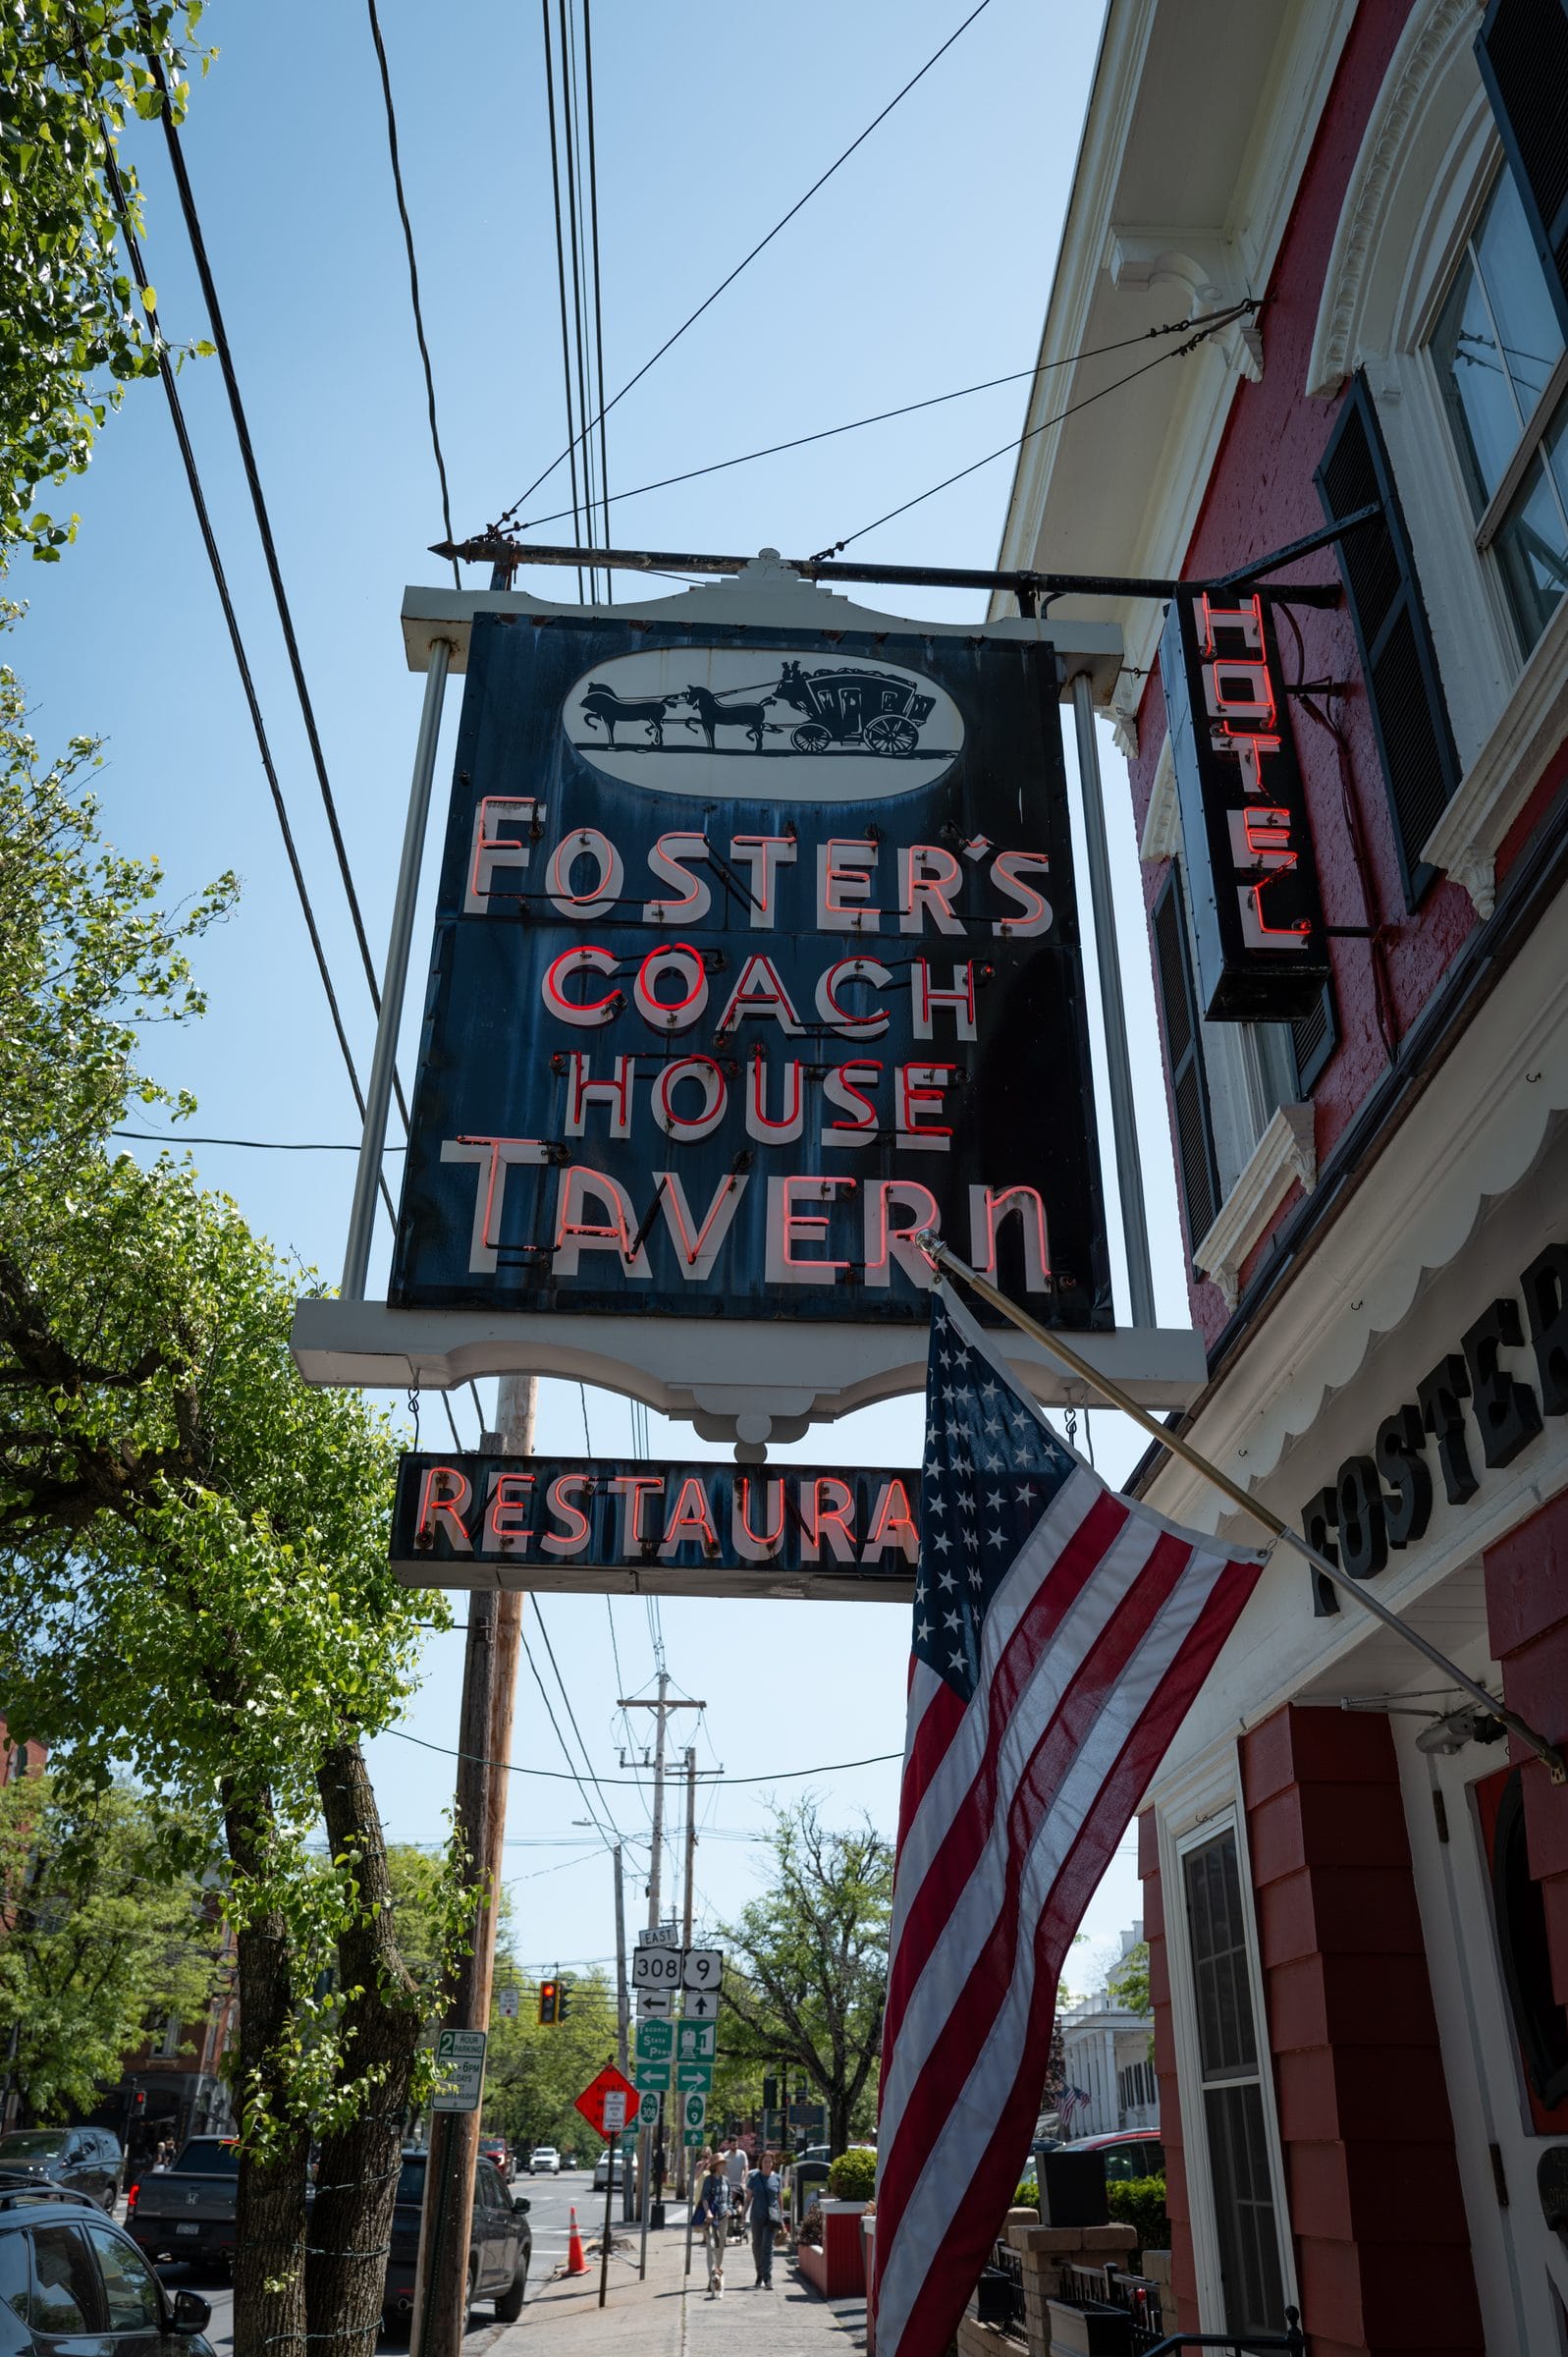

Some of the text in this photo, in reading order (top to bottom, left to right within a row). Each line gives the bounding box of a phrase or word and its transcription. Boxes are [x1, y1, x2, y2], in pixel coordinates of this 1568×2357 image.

[1191, 591, 1311, 950] HOTEL
[462, 796, 1054, 938] FOSTER'S
[541, 943, 978, 1042] COACH
[563, 1050, 959, 1151] HOUSE
[644, 1929, 672, 1945] EAST
[637, 1958, 677, 1978] 308
[696, 1959, 710, 1980] 9
[440, 2033, 454, 2055] 2
[455, 2045, 482, 2054] PARKING
[460, 2035, 478, 2044] HOUR
[462, 2061, 479, 2072] 6PM
[642, 2108, 656, 2118] 308
[691, 2112, 699, 2121] 9
